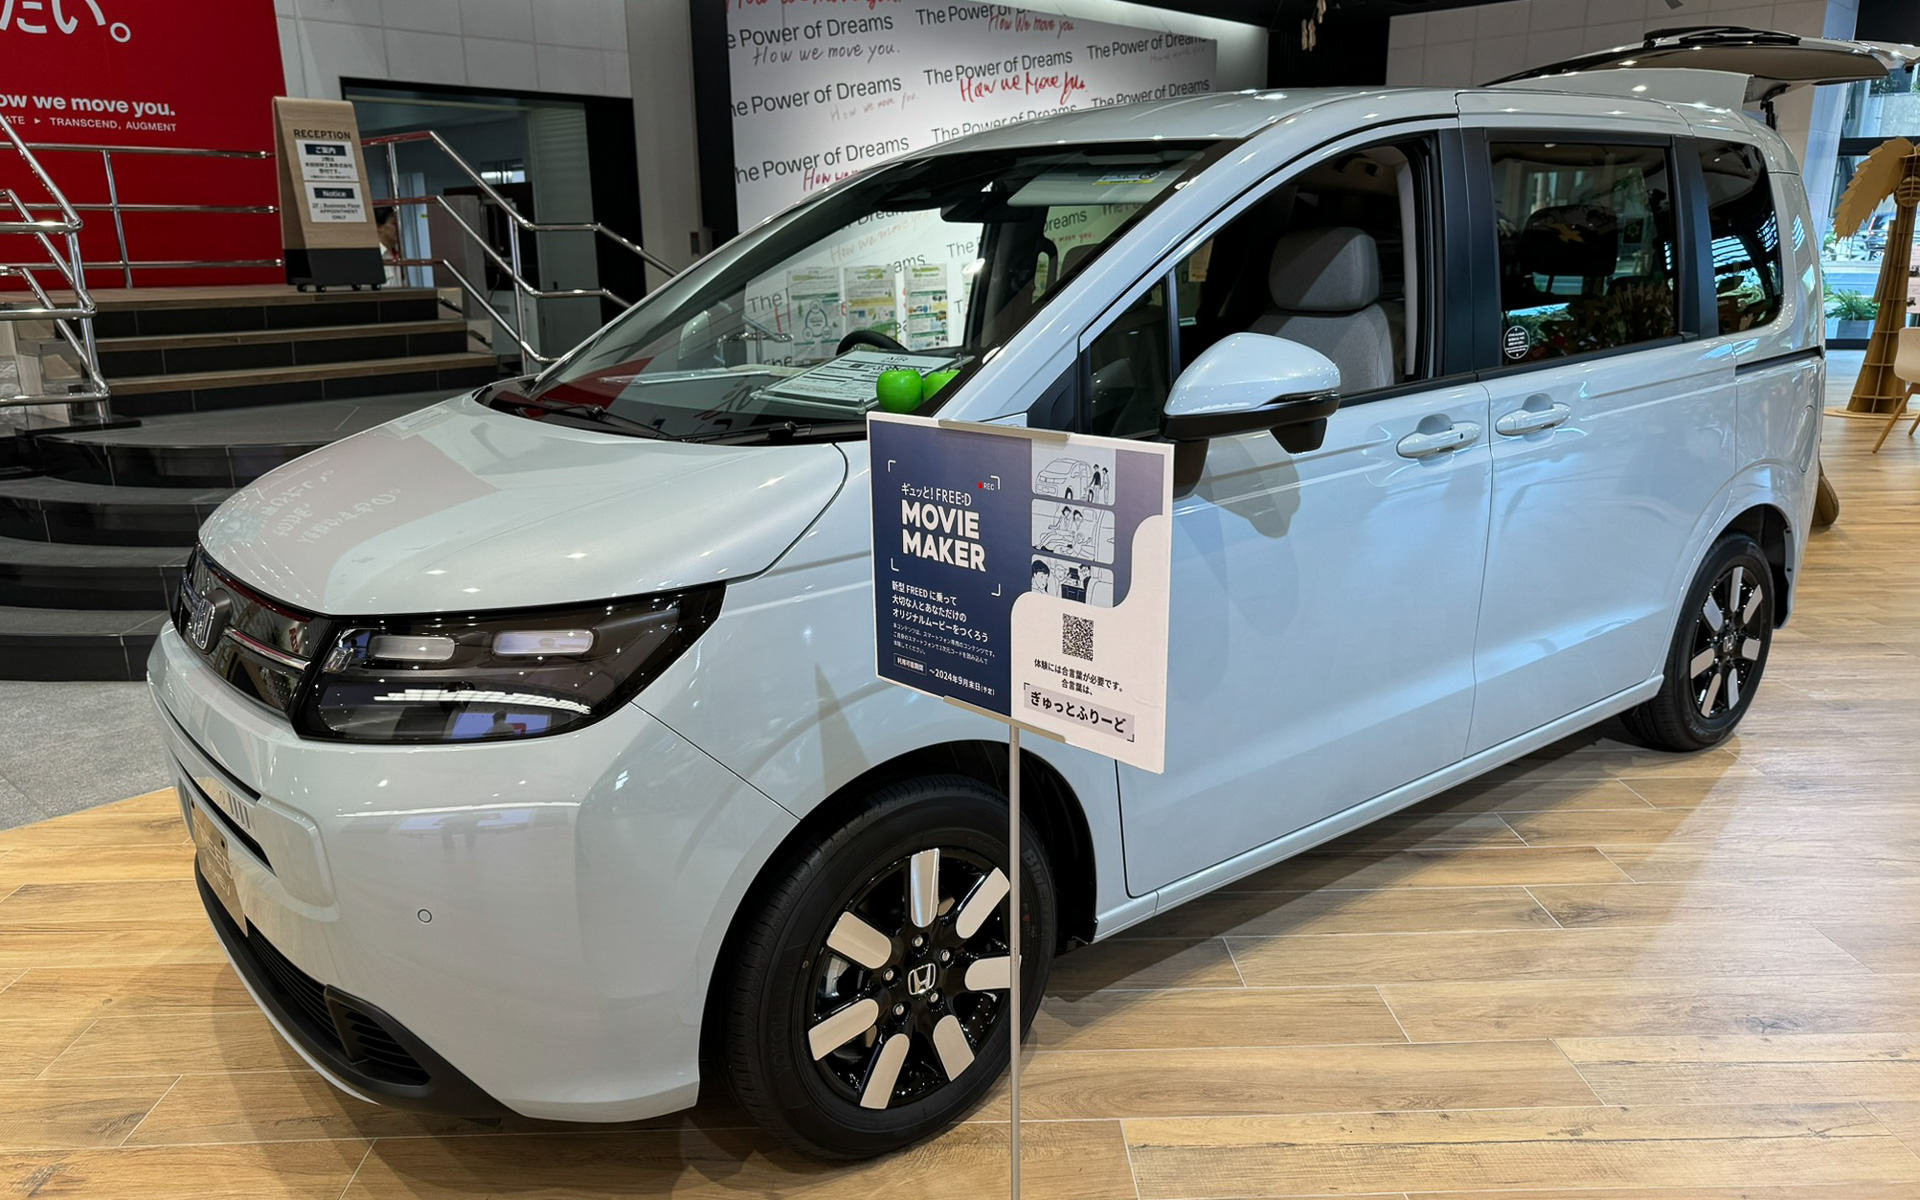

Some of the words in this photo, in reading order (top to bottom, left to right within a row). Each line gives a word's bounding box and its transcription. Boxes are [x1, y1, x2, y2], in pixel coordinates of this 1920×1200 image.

[916, 9, 946, 26] The
[948, 5, 993, 22] Power
[988, 13, 1012, 32] How
[739, 26, 800, 47] Power
[803, 21, 822, 40] of
[826, 15, 894, 37] Dreams
[752, 46, 793, 66] How
[800, 48, 824, 62] we
[828, 44, 863, 59] move
[867, 43, 900, 64] you.
[1086, 45, 1110, 60] The
[1112, 38, 1150, 56] Power
[1151, 35, 1163, 50] of
[923, 68, 953, 86] The
[955, 61, 1001, 82] Power
[1003, 56, 1019, 73] of
[1021, 51, 1073, 71] Dreams
[751, 91, 810, 114] Power
[814, 84, 833, 104] of
[836, 77, 902, 100] Dreams
[960, 76, 997, 103] How
[1000, 75, 1023, 91] we
[1116, 92, 1154, 105] Power
[1154, 84, 1167, 100] of
[1168, 79, 1210, 98] Dreams
[0, 94, 28, 108] ow
[32, 95, 67, 110] we
[71, 97, 129, 113] move
[131, 101, 176, 118] you.
[4, 115, 26, 125] ATE
[50, 117, 122, 131] TRANSCEND,
[126, 121, 177, 132] AUGMENT
[293, 128, 351, 140] RECEPTION
[931, 127, 960, 144] The
[735, 165, 760, 184] he
[762, 154, 820, 179] Power
[824, 147, 842, 166] of
[845, 137, 910, 162] Dreams
[803, 167, 831, 192] How
[322, 190, 347, 198] Notice
[946, 241, 974, 258] The
[893, 254, 926, 274] ams
[746, 293, 783, 313] The
[983, 482, 995, 491] REC
[901, 499, 980, 540] MOVIE
[902, 528, 987, 573] MAKER
[891, 580, 906, 594] 新型
[906, 584, 929, 599] FREED
[929, 590, 958, 607] に乗って
[891, 594, 968, 623] 大切な人とあなただけの
[892, 607, 989, 643] オリジナルムービーをつくろう
[1034, 658, 1123, 693] 体験には合言葉が必要です。
[1061, 678, 1093, 696] 合言葉は、
[1030, 690, 1127, 734] ぎゅっとふりーど
